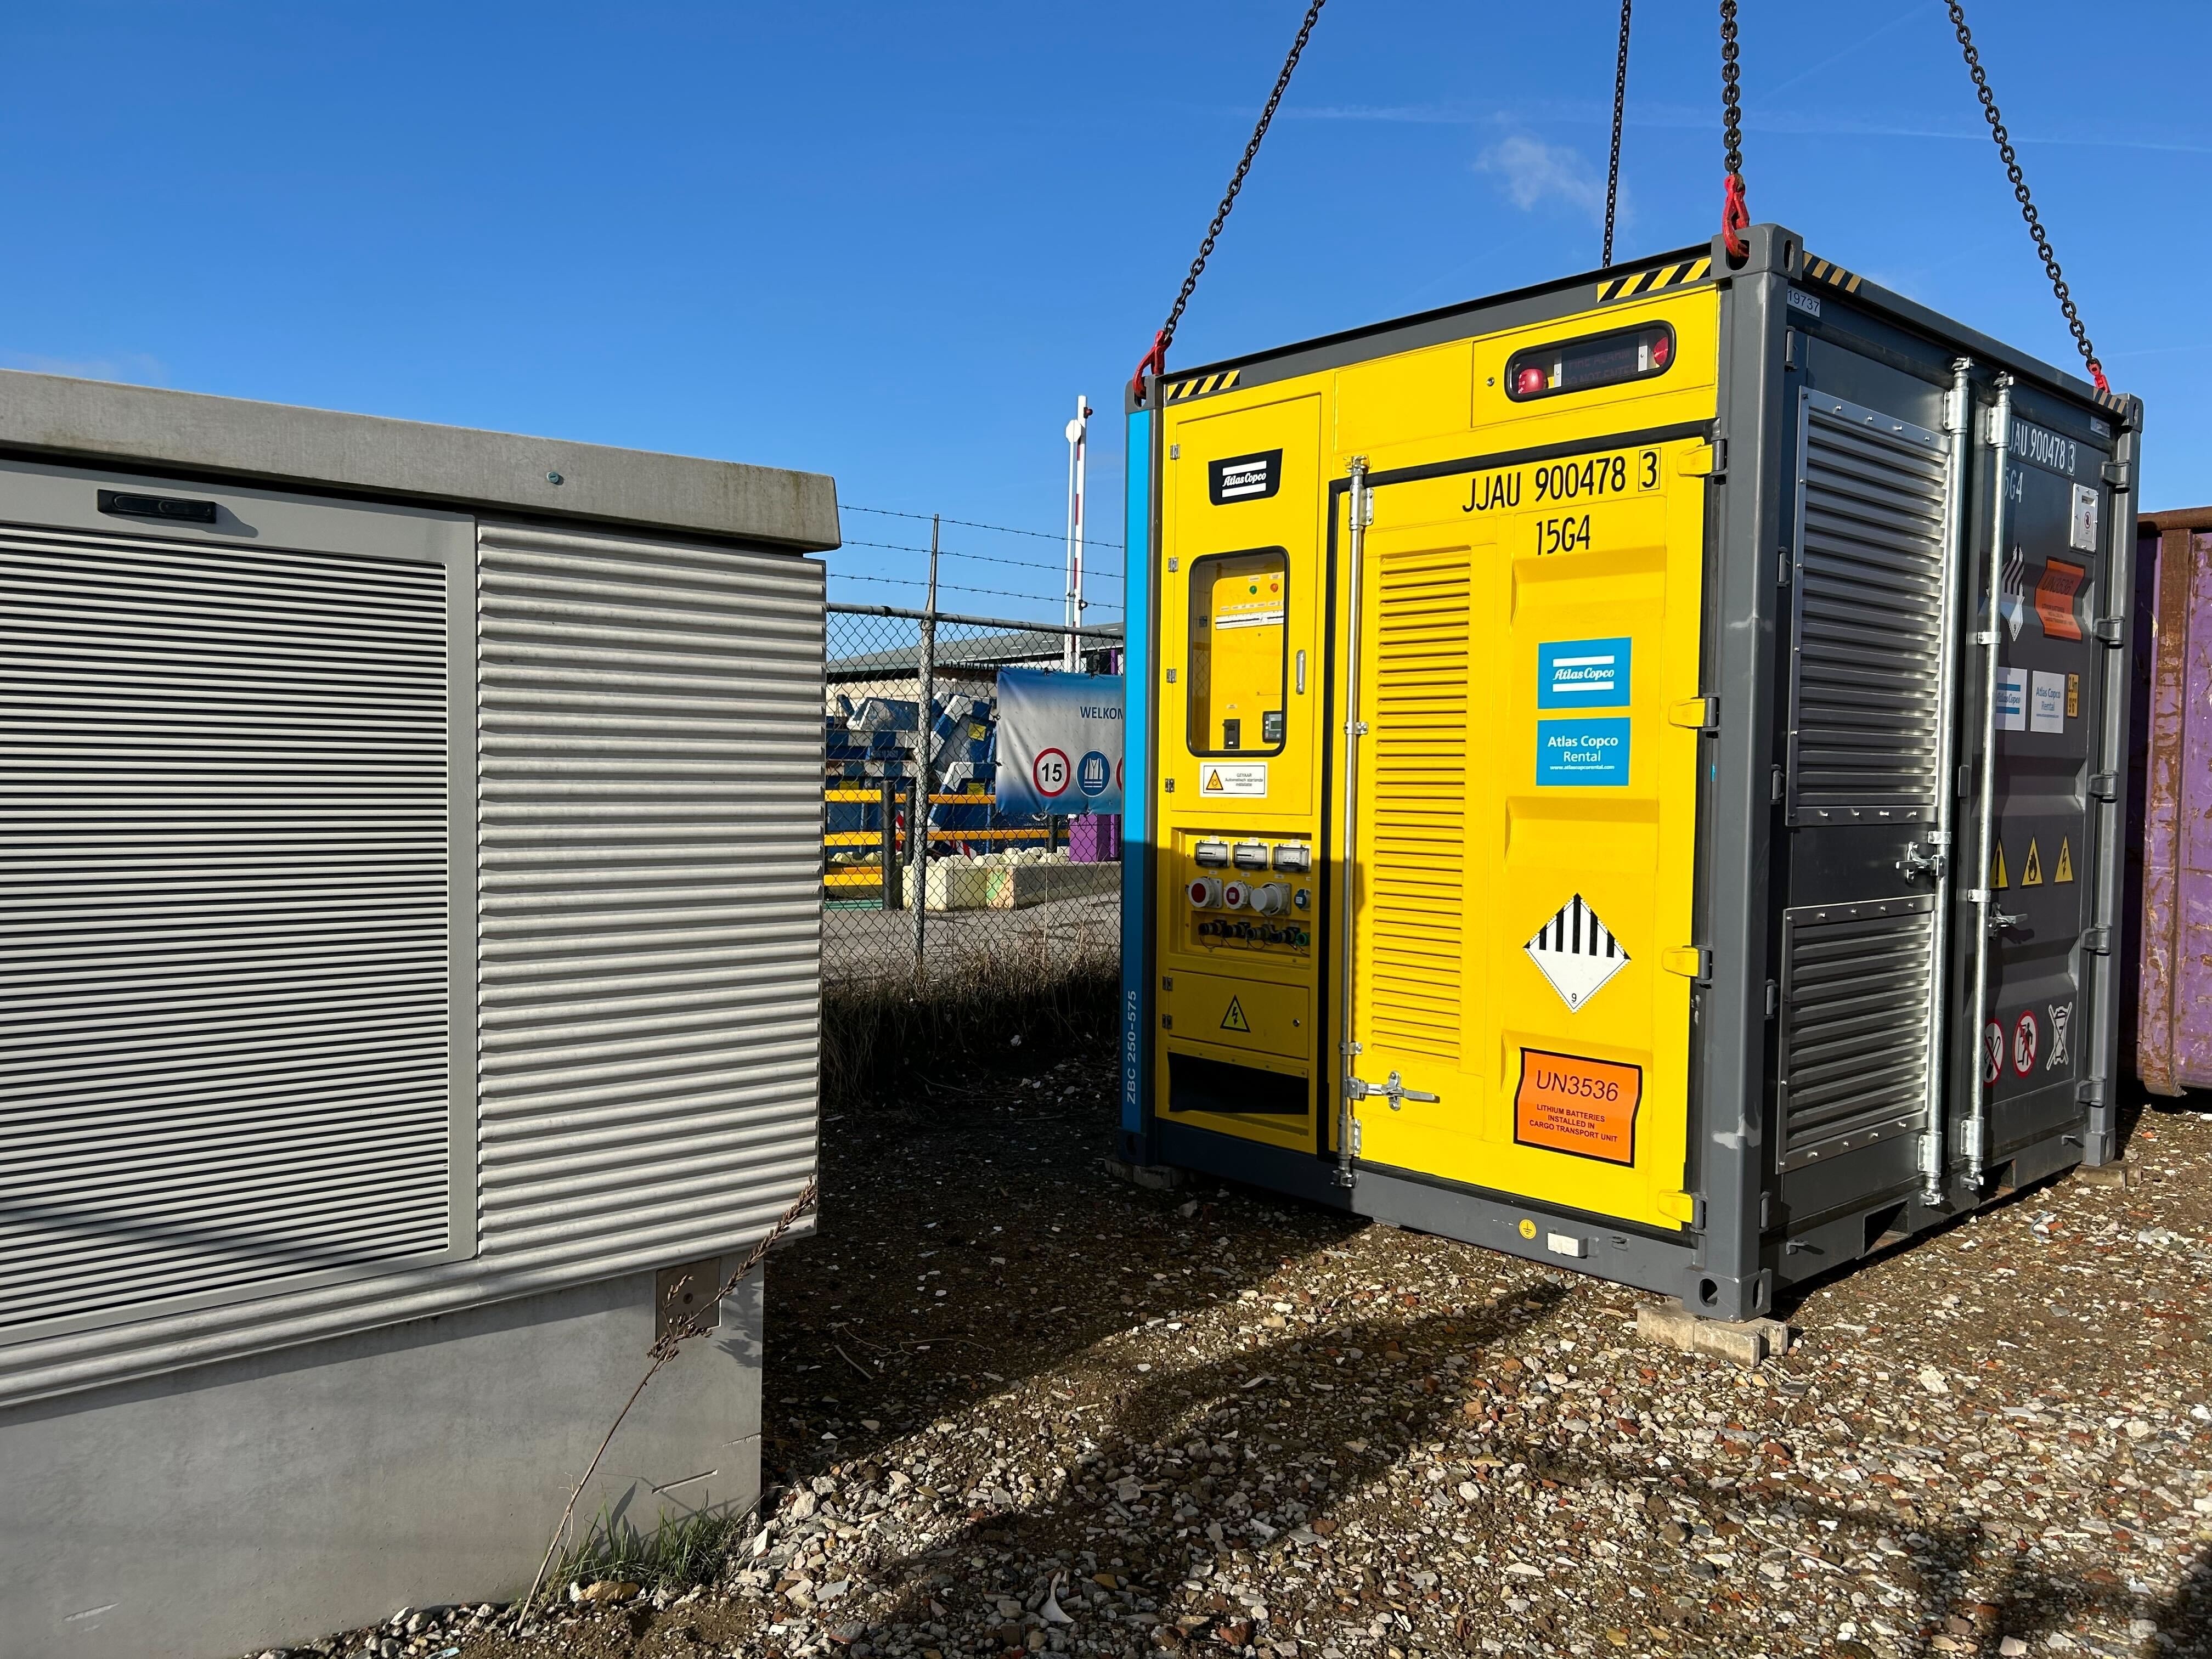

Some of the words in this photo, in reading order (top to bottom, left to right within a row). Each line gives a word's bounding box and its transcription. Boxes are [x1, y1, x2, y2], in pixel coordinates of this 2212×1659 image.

[1787, 289, 1820, 312] 19737
[2008, 421, 2028, 456] JAU
[2030, 428, 2066, 470] 900478
[2068, 443, 2075, 473] 3
[1462, 472, 1521, 513] JJAU
[1535, 455, 1627, 502] 900478
[1641, 451, 1657, 488] 3
[1536, 514, 1591, 556] 15G4
[2036, 687, 2047, 697] Atlas
[2047, 687, 2061, 699] Copco
[2041, 701, 2055, 712] Rental
[1547, 735, 1578, 748] Atlas
[1581, 735, 1618, 749] Copco
[1564, 750, 1601, 763] Rental
[1041, 763, 1062, 782] 15
[1571, 993, 1577, 1003] 9
[1127, 990, 1137, 1063] 250-575
[1127, 1068, 1136, 1105] ZBC
[1536, 1070, 1619, 1102] UN3536
[1536, 1103, 1565, 1115] LITHIUM
[1566, 1109, 1605, 1122] BATTERIES
[1548, 1114, 1585, 1128] INSTALLED
[1529, 1120, 1555, 1130] CARGO
[1555, 1125, 1599, 1139] TRANSPORT
[1600, 1133, 1618, 1142] UNIT
